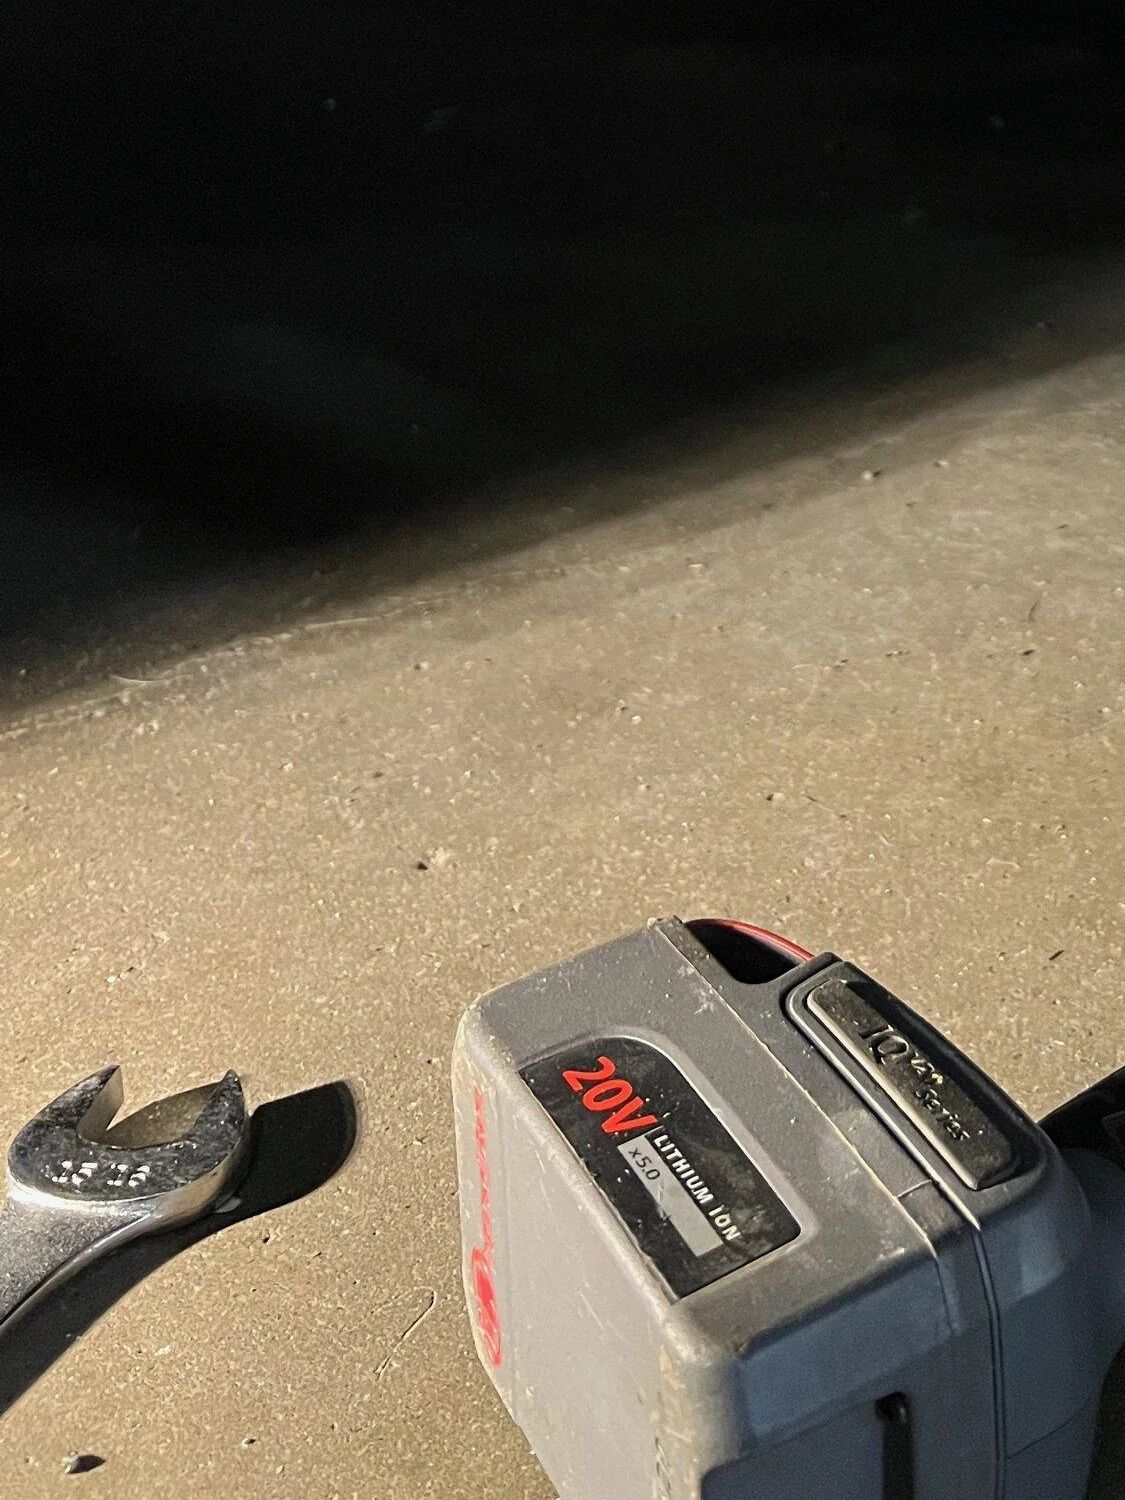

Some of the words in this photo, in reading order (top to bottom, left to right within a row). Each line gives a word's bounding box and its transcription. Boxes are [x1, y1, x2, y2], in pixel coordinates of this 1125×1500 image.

[562, 1055, 660, 1134] 20V
[654, 1133, 715, 1205] LITHIUM
[708, 1204, 742, 1242] ION
